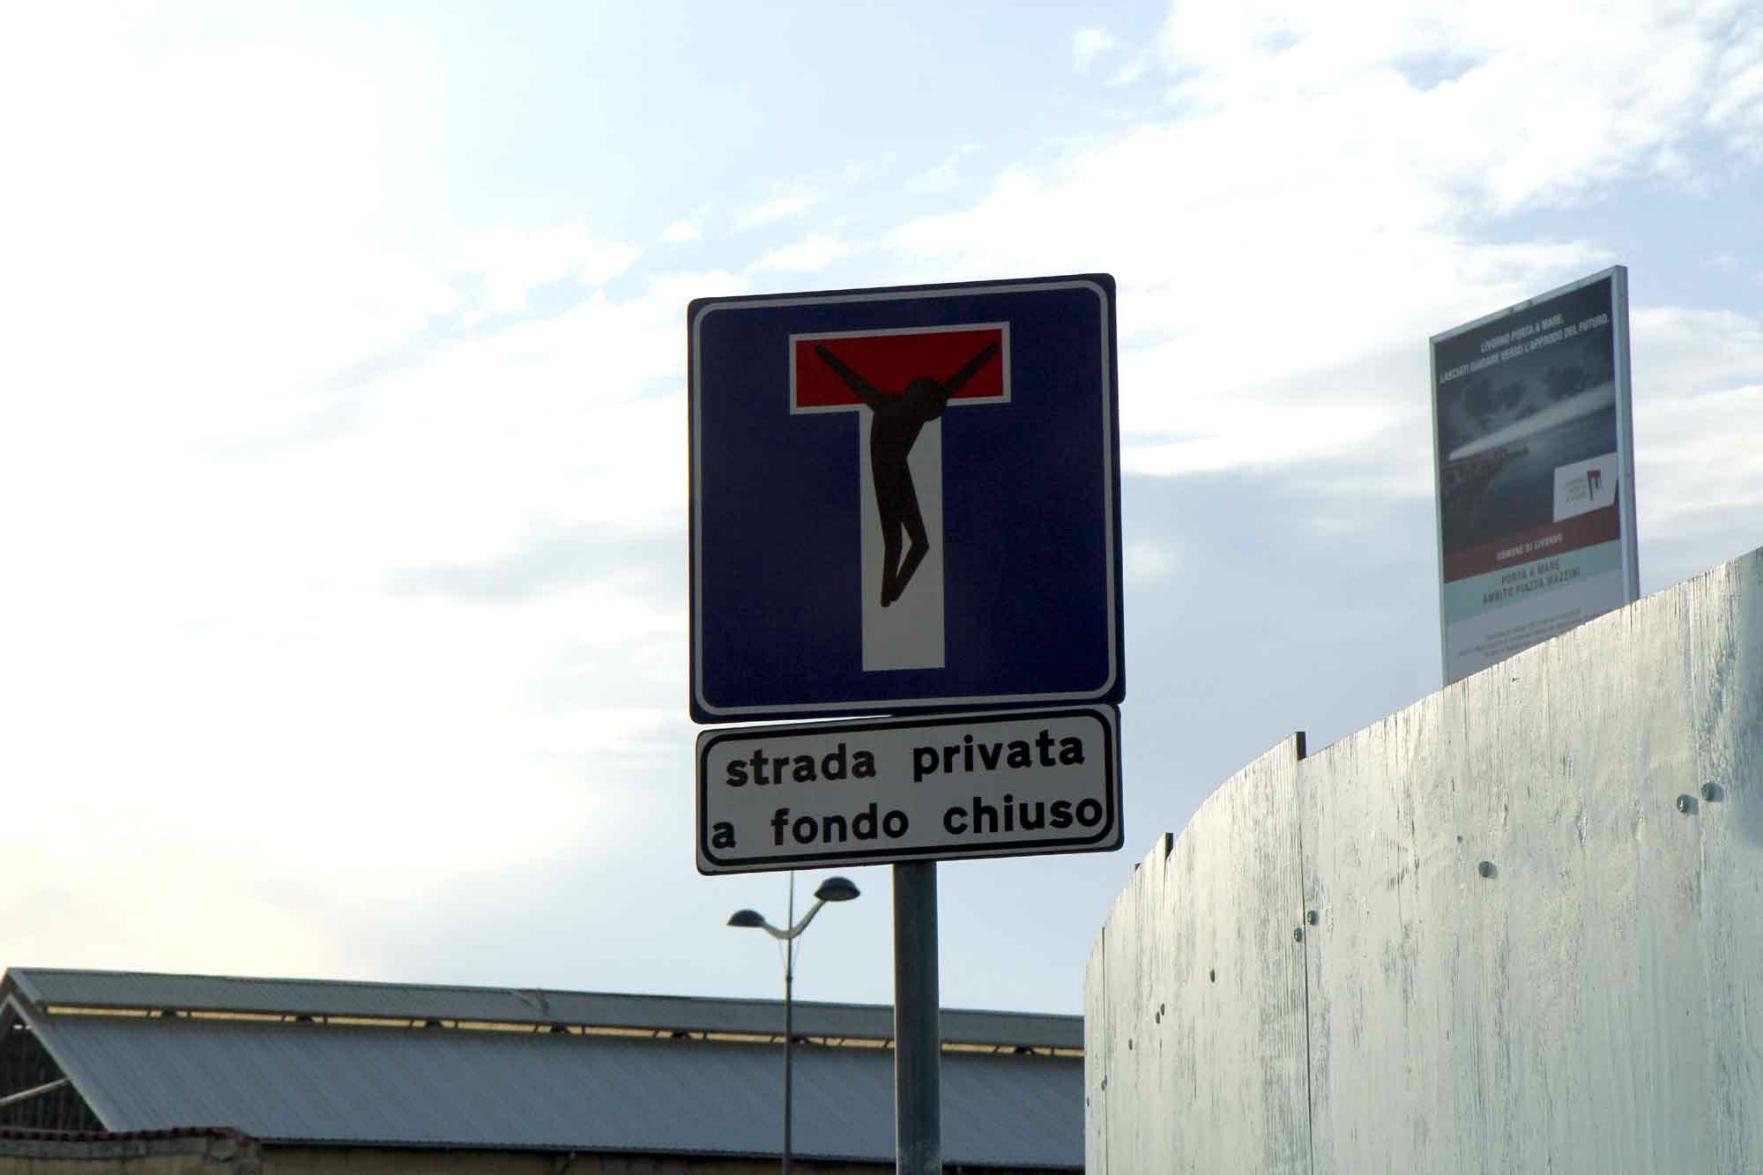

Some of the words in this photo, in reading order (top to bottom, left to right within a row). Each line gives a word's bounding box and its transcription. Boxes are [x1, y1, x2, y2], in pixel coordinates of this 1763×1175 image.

[726, 743, 877, 787] strada
[913, 728, 1086, 783] privata
[711, 819, 737, 849] a
[770, 803, 909, 846] fondo
[943, 793, 1102, 835] chiuso
